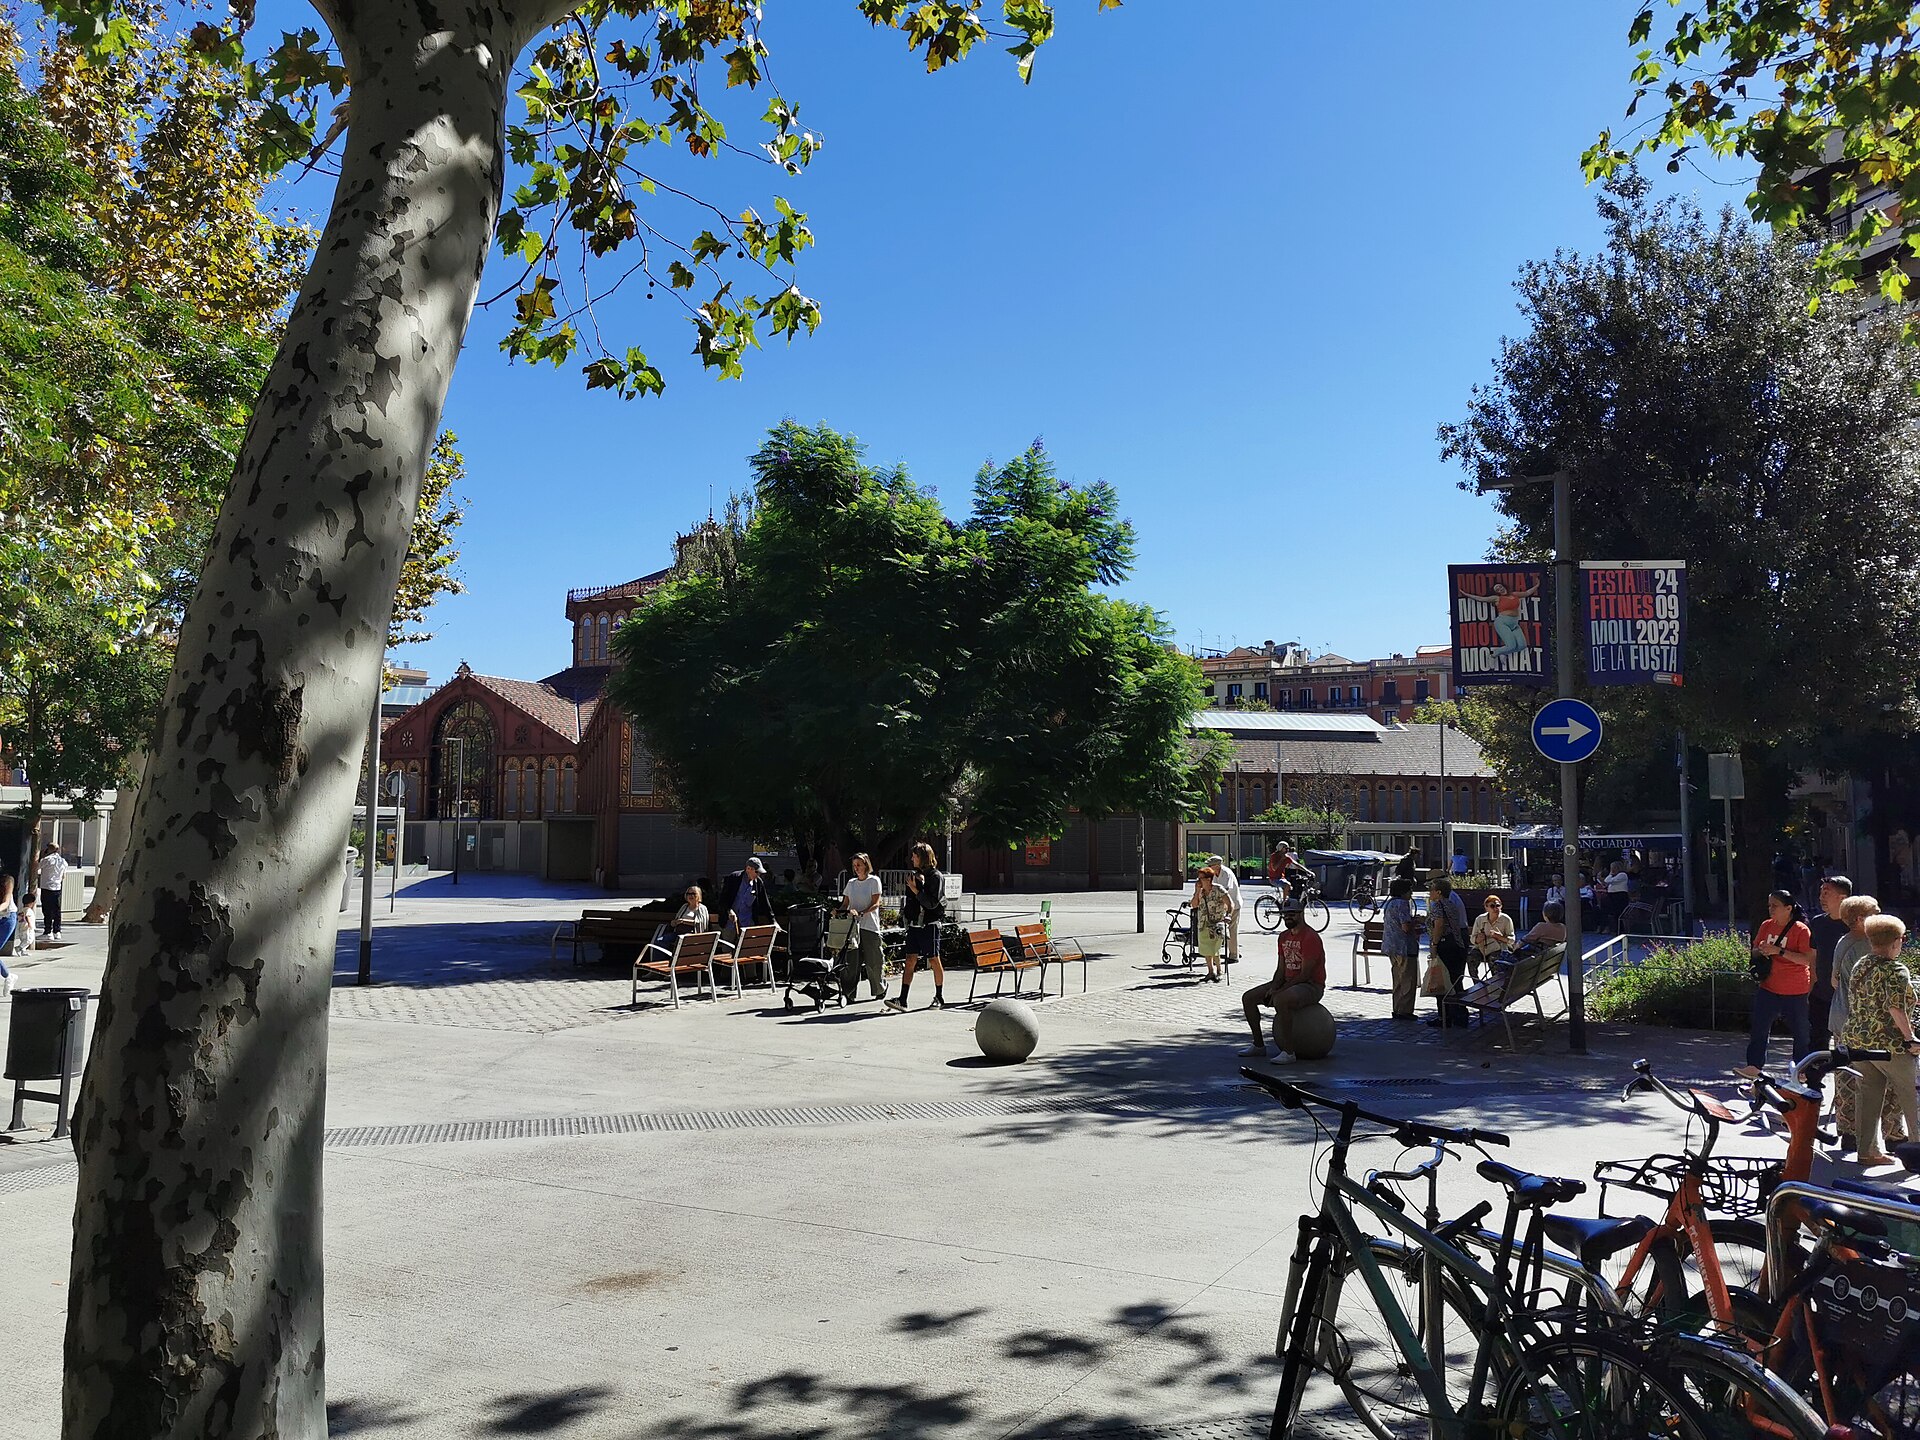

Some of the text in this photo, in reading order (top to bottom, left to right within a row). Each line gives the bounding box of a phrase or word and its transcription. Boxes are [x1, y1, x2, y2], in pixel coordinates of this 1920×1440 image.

[1589, 570, 1636, 594] FESTA
[1655, 570, 1679, 594] 24
[1458, 597, 1541, 622] MOTA'T
[1590, 594, 1679, 619] FITNES 09
[1459, 621, 1542, 647] MOTA'T
[1591, 619, 1680, 646] MOLL 2023
[1592, 645, 1677, 672] DE LA FUSTA
[1578, 839, 1643, 849] ANGUARDIA
